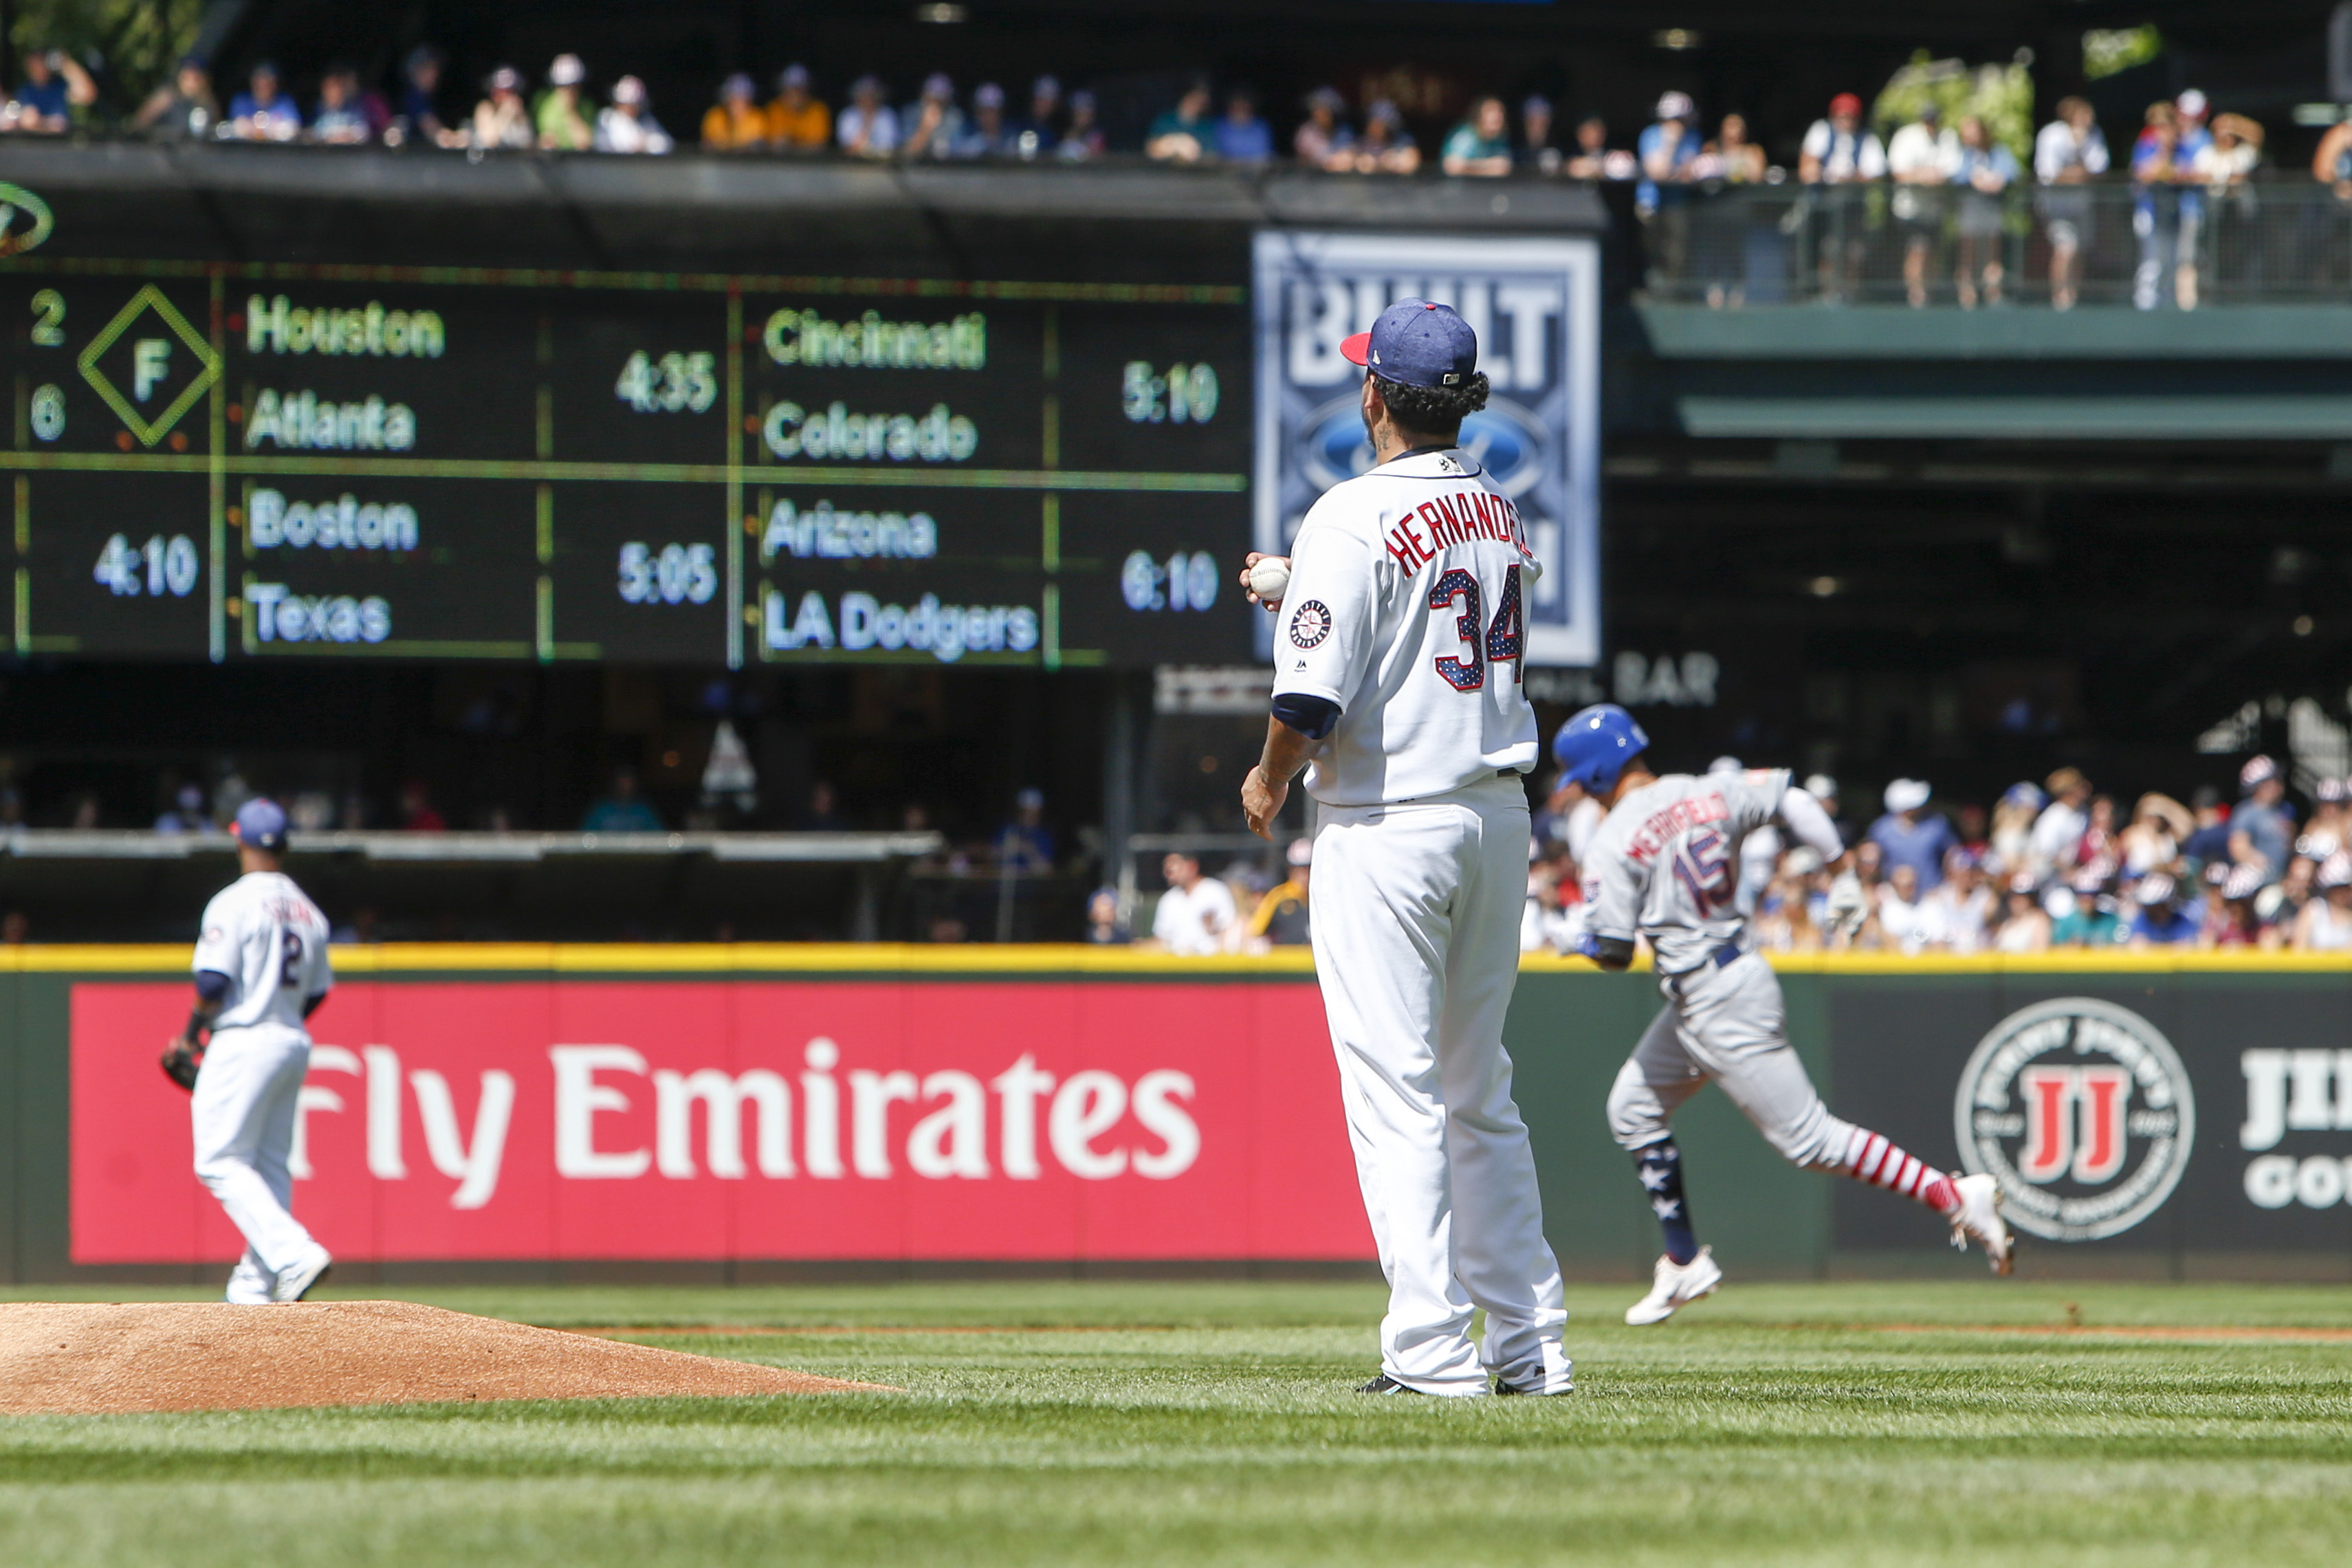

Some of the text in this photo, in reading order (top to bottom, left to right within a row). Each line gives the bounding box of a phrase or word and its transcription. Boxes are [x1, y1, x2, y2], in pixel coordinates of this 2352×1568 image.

[31, 287, 66, 347] 2
[247, 294, 446, 358] Houston
[763, 308, 986, 370] Cincinnati
[133, 338, 172, 404] F
[616, 351, 717, 412] 4:35
[1122, 361, 1219, 423] 5:10
[245, 388, 417, 450] Atlanta
[762, 401, 978, 461] Colorado
[249, 487, 419, 550] Boston
[762, 498, 937, 559] Arizona
[93, 532, 199, 597] 4:10
[617, 540, 717, 604] 5:05
[1121, 549, 1219, 612] 6:10
[244, 582, 391, 643] Texas
[765, 591, 1040, 663] LA Dodgers
[1428, 562, 1524, 692] 34
[1613, 652, 1719, 707] BAR
[1674, 828, 1733, 921] 15
[279, 929, 303, 989] 2
[292, 1035, 1202, 1210] Fly Emirates
[2238, 1047, 2352, 1153] JI
[2242, 1153, 2352, 1211] GO
